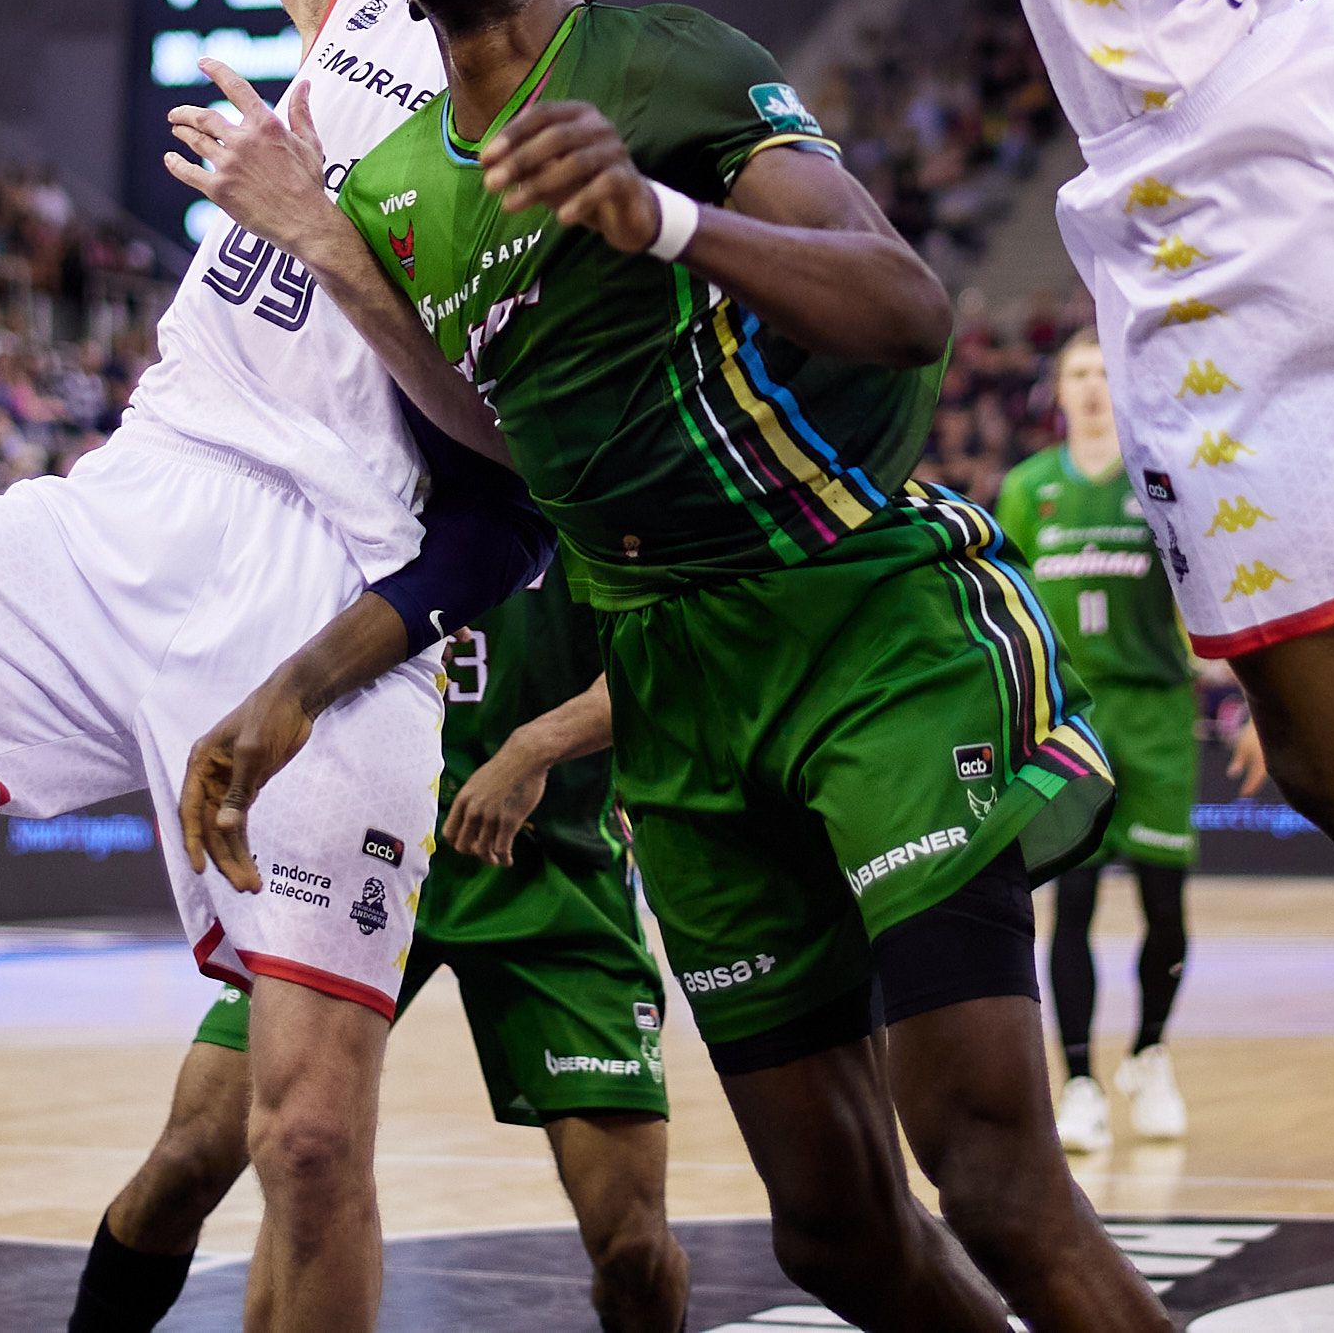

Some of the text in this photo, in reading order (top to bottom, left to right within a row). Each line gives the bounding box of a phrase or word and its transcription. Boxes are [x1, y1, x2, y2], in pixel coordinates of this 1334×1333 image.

[379, 189, 418, 216] vive
[201, 222, 319, 332] 99
[959, 757, 988, 776] acb
[365, 841, 395, 862] acb
[857, 826, 969, 887] BERNER
[271, 862, 332, 890] andorra
[269, 879, 331, 909] telecom
[683, 960, 753, 993] asisa
